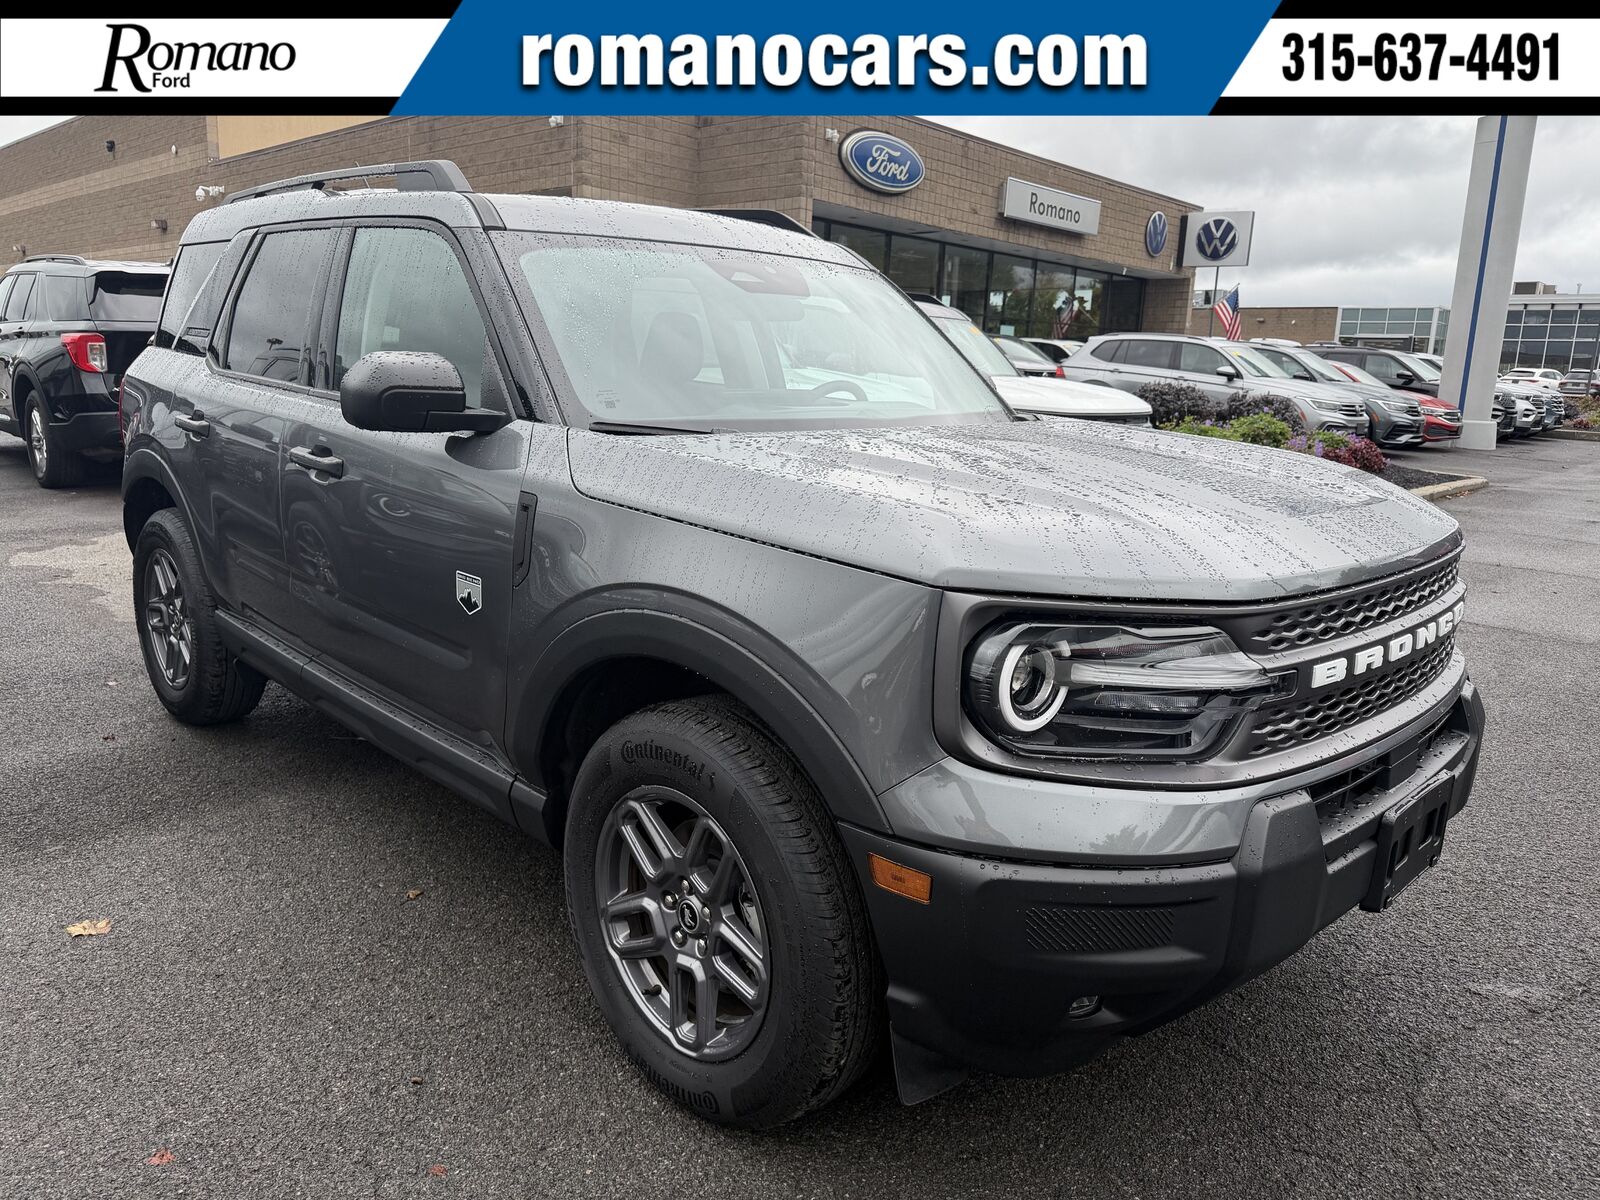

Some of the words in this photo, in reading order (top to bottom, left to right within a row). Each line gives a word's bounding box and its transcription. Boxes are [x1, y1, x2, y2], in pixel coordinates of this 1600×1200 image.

[866, 144, 910, 181] Ford
[1029, 192, 1081, 224] Romano
[1311, 601, 1465, 688] BRONCO
[621, 739, 706, 780] Continental
